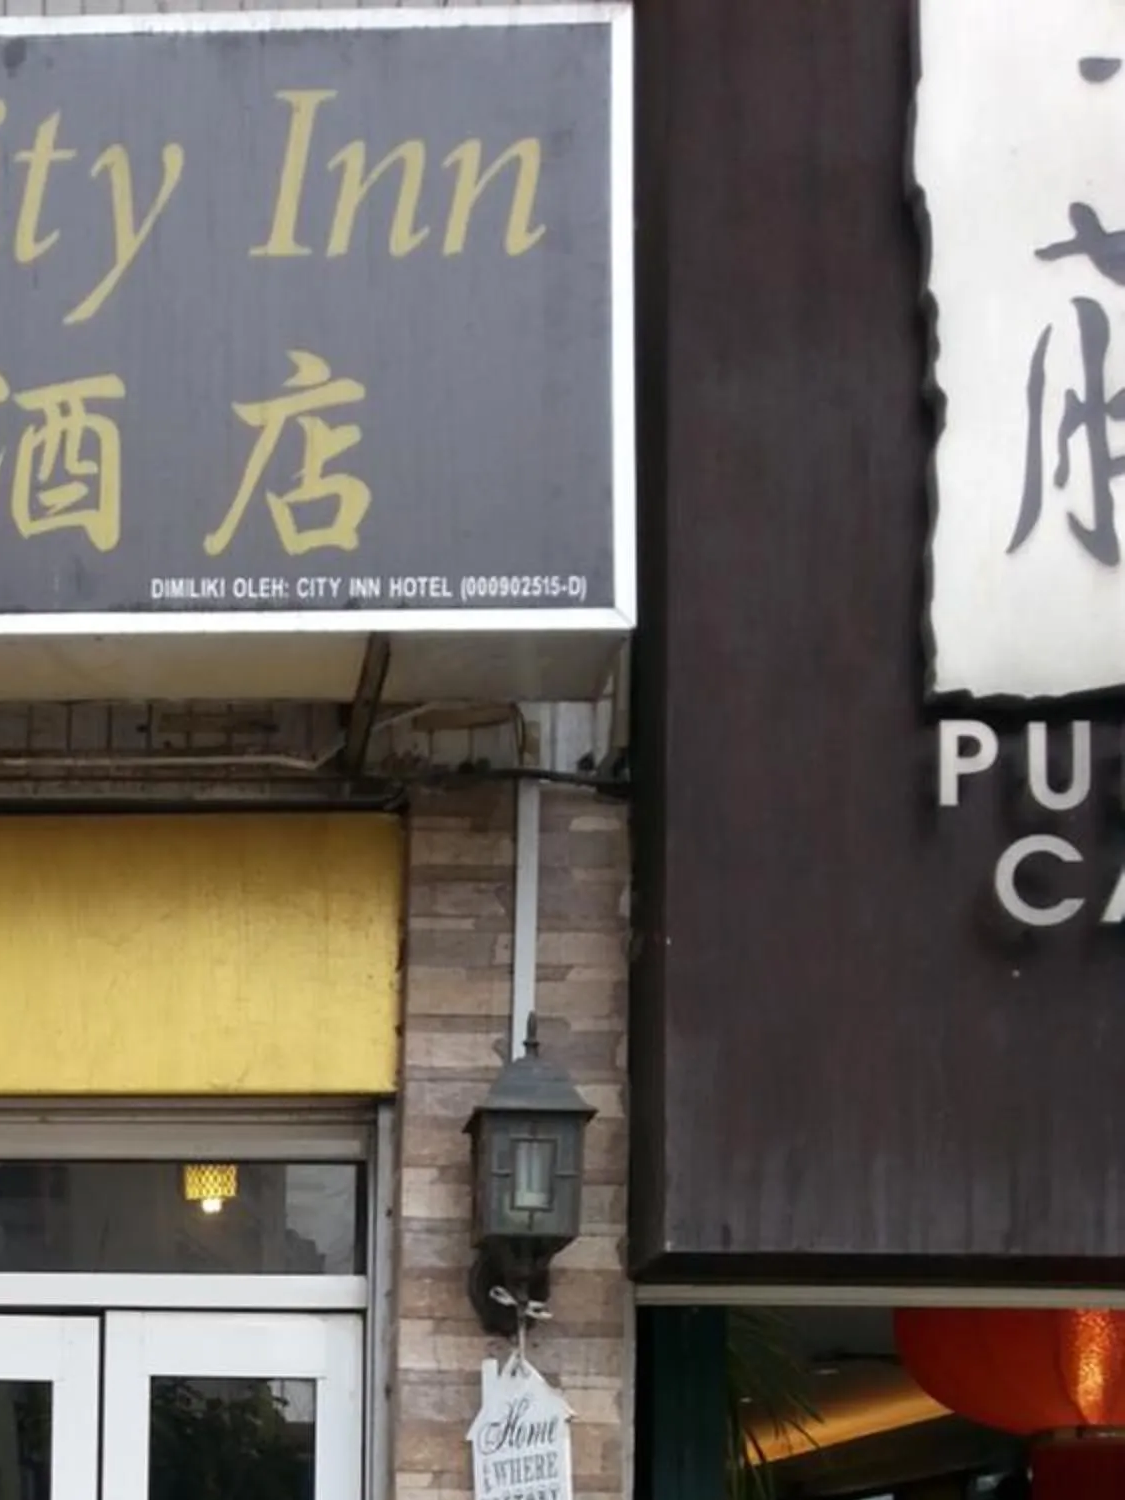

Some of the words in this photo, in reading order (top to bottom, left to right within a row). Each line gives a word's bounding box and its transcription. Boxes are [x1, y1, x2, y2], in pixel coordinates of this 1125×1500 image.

[250, 90, 545, 256] Inn
[151, 577, 225, 598] DIMILIKI
[233, 577, 290, 598] OLEH:
[296, 576, 341, 598] CITY
[349, 576, 381, 598] INN
[389, 576, 452, 598] HOTEL
[995, 834, 1125, 926] C
[477, 1397, 559, 1455] Home
[492, 1452, 558, 1487] WHERE
